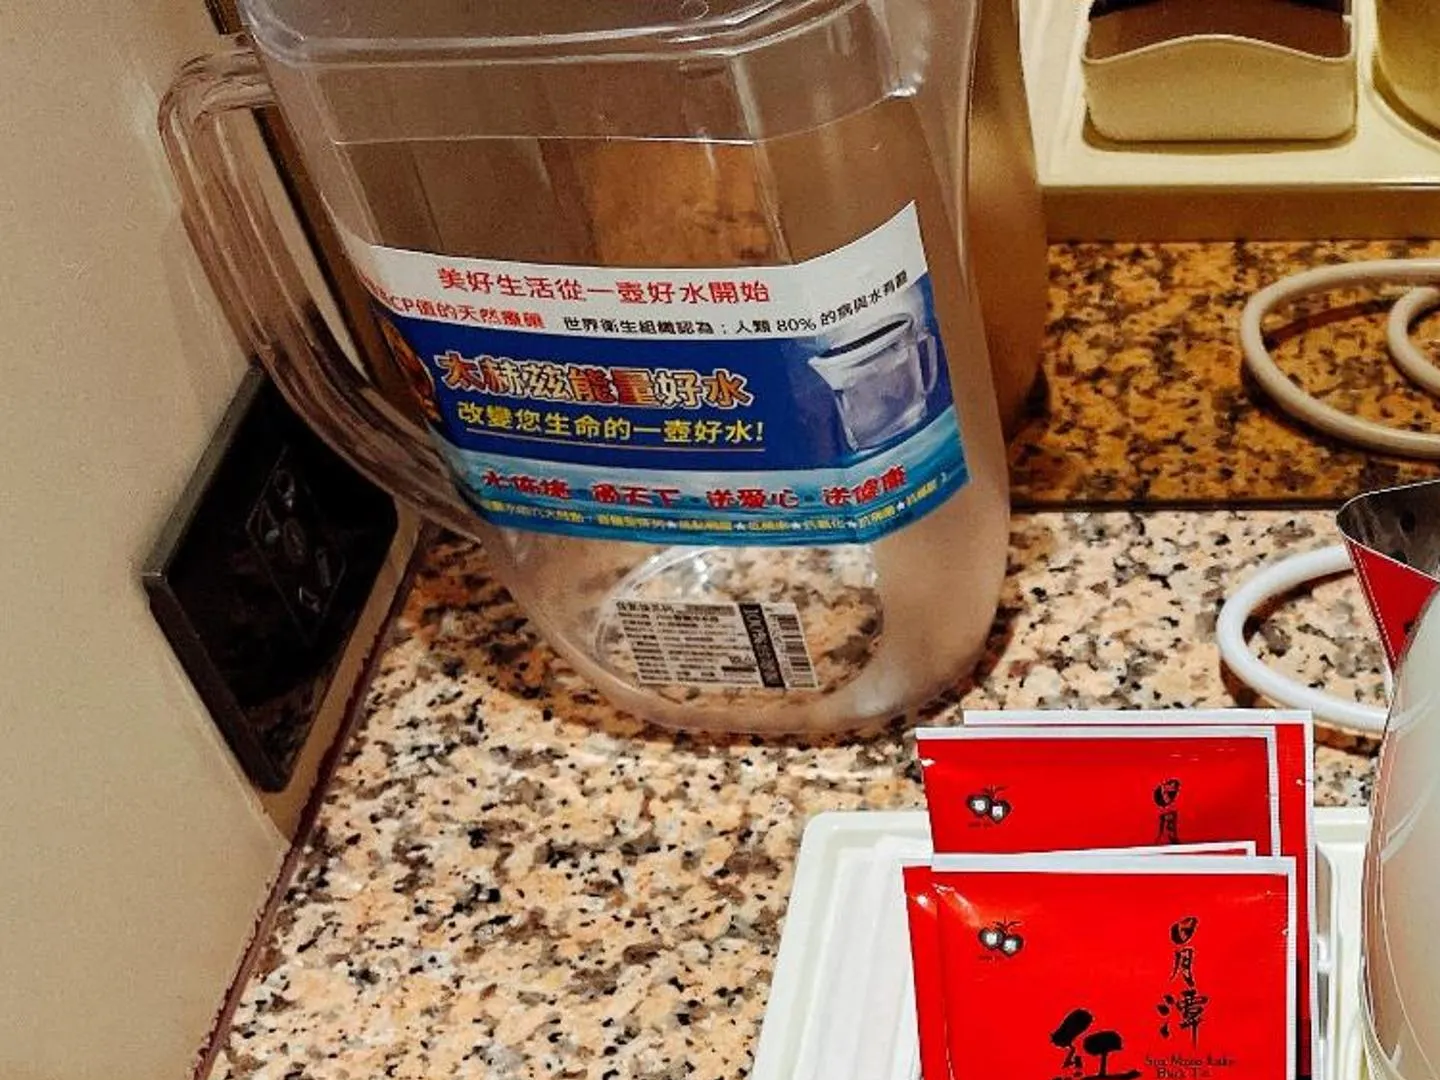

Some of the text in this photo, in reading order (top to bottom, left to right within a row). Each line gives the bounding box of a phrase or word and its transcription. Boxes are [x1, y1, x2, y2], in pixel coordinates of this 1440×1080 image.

[437, 266, 771, 305] 美好生活從一壺好水開始
[434, 350, 755, 410] 太赫茲能量好水
[1156, 916, 1209, 1049] 日月潭
